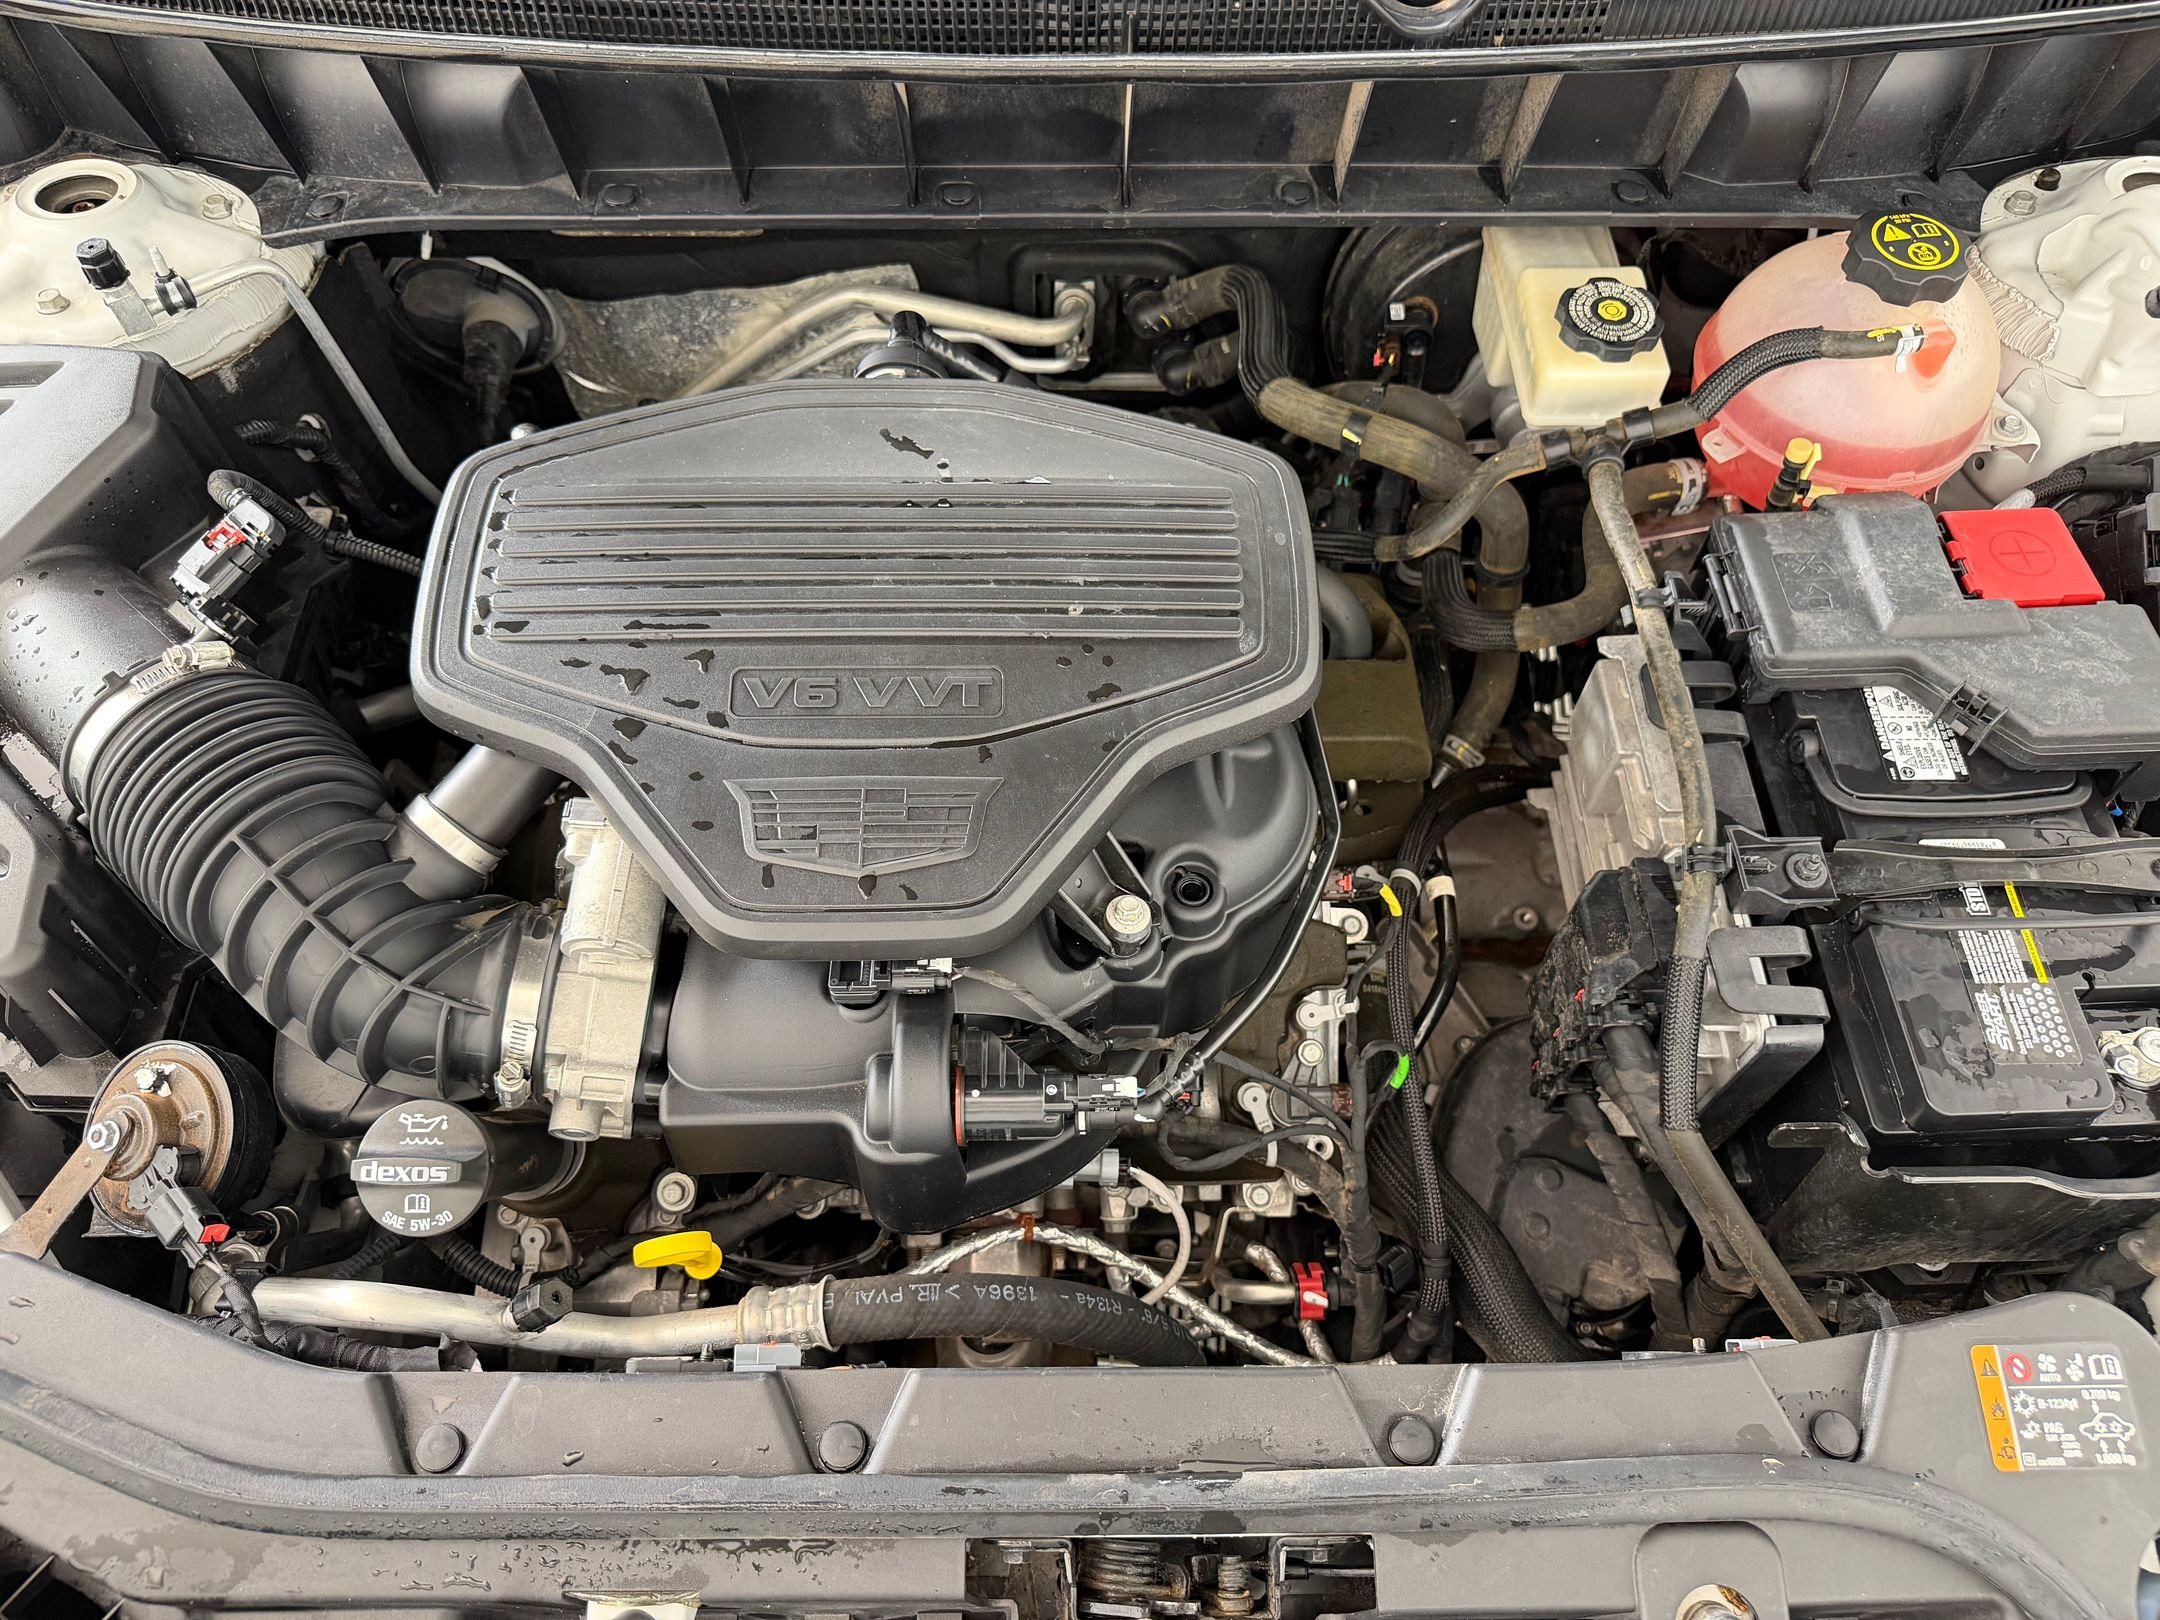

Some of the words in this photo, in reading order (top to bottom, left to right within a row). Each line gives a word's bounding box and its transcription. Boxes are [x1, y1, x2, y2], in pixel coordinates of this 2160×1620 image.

[742, 676, 839, 709] V6
[852, 676, 994, 709] VVT
[1863, 685, 1891, 750] DANGER/POI
[1974, 991, 1999, 1045] SUPER
[360, 1160, 448, 1182] dexos
[381, 1210, 406, 1230] SAE
[409, 1210, 454, 1232] 5W-30
[973, 1284, 1038, 1301] 1396A
[1075, 1291, 1122, 1315] R134a
[2039, 1373, 2063, 1383] AUTO
